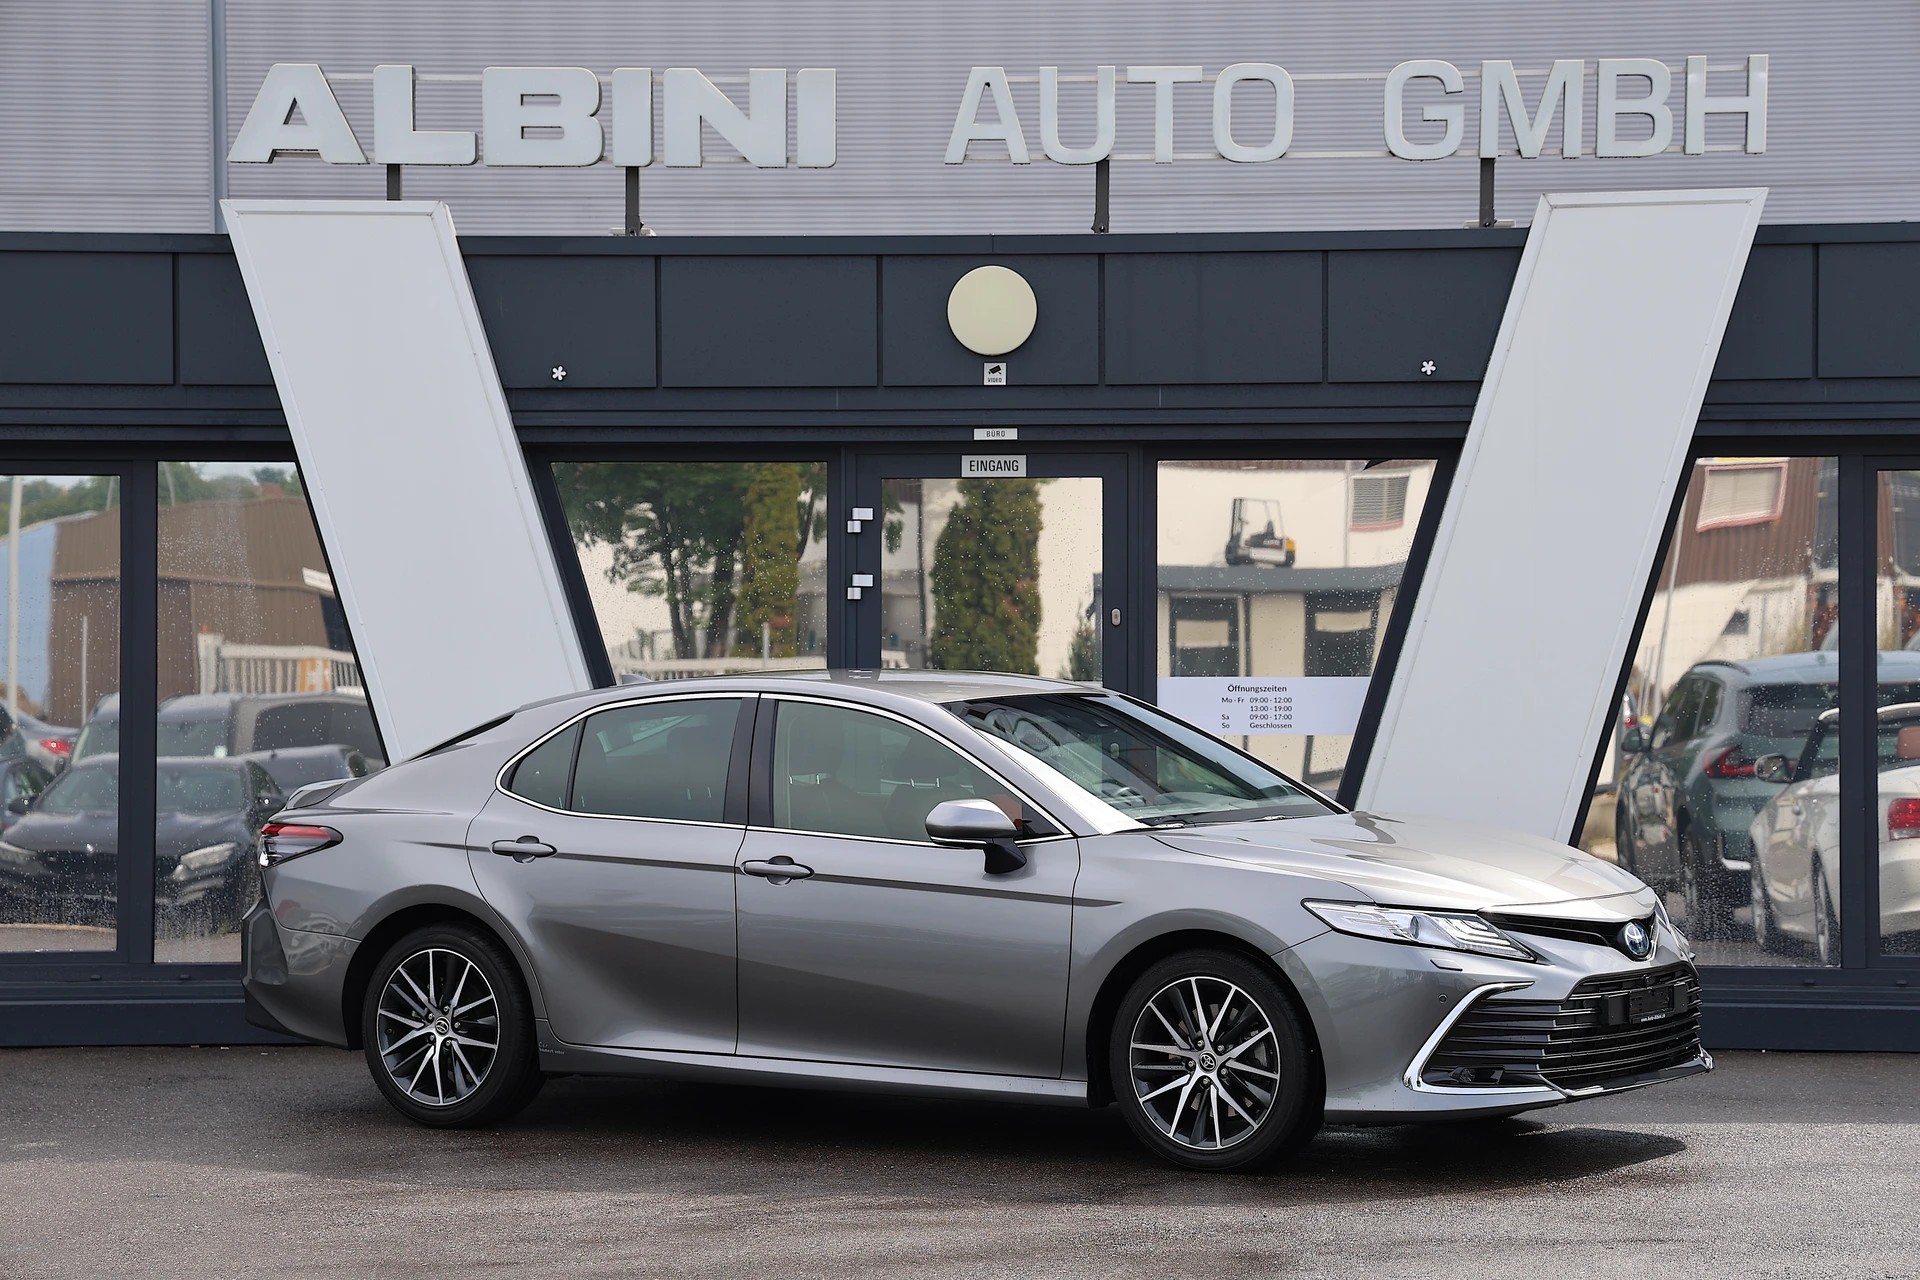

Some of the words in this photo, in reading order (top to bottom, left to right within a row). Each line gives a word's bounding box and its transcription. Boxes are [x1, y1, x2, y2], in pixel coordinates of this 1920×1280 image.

[226, 63, 837, 168] ALBINI
[944, 62, 1295, 165] AUTO
[1384, 54, 1768, 161] GMBH
[969, 459, 1019, 472] EINGANG
[1227, 684, 1288, 694] Öffnungszeiten
